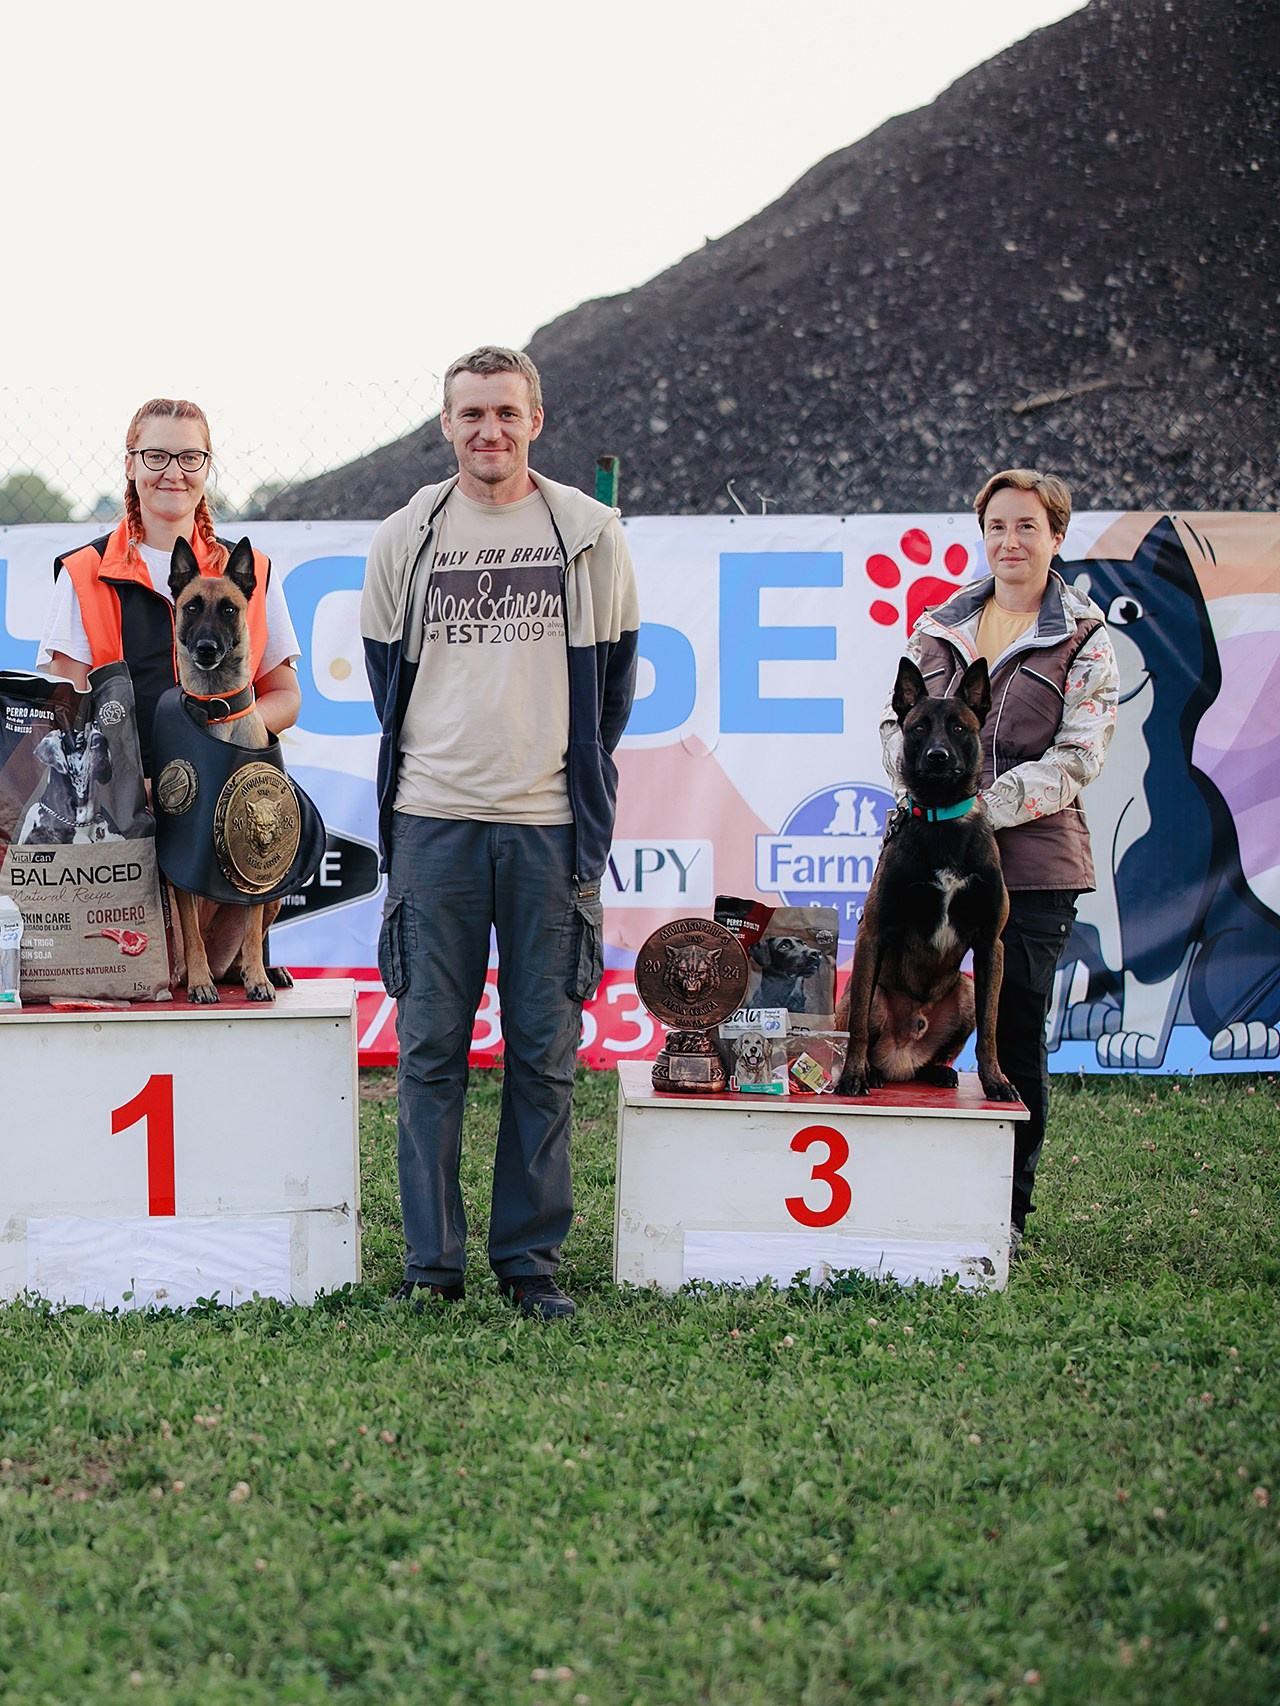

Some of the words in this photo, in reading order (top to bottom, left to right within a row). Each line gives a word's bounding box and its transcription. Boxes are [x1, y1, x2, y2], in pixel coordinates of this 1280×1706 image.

[475, 549, 506, 565] FOR
[511, 547, 560, 563] BRAVE
[6, 706, 29, 718] PERRO
[29, 708, 55, 721] ADULTO
[770, 844, 884, 883] Farm
[11, 862, 142, 886] BALANCED
[11, 886, 67, 903] Natural
[72, 888, 116, 904] Recipe
[21, 912, 42, 924] SKIN
[45, 912, 71, 924] CARE
[87, 905, 145, 924] CORDERO
[33, 938, 54, 947] TRIGO
[33, 951, 53, 959] SOJA
[29, 967, 84, 977] ANTIOXIDANTES
[86, 965, 127, 975] NATURALES
[644, 959, 661, 973] 20
[722, 965, 740, 979] 24
[111, 1074, 176, 1217] 1
[785, 1125, 852, 1228] 3
